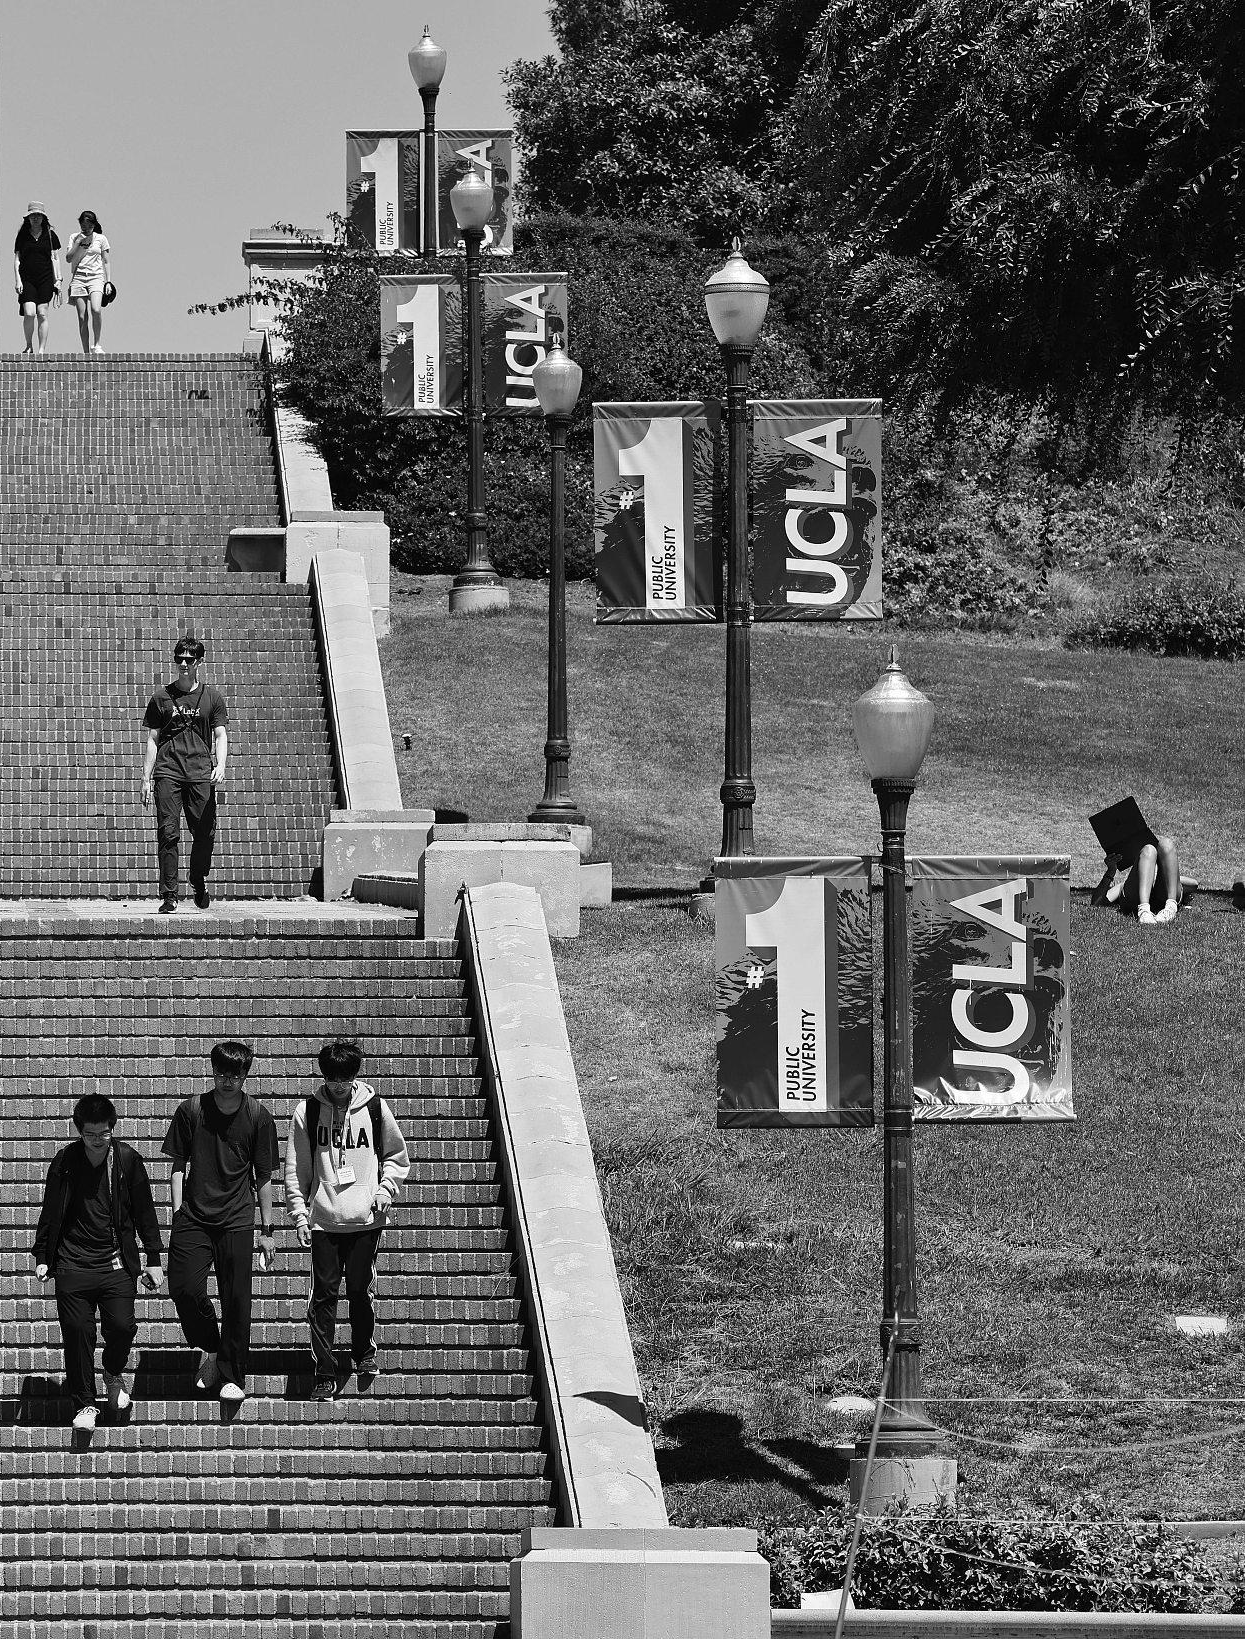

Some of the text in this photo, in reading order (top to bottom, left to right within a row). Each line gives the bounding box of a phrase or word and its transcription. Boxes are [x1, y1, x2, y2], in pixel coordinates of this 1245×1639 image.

[361, 138, 398, 250] #1
[379, 219, 387, 245] PUBLIC
[386, 201, 394, 246] UNIVERSITY
[397, 284, 439, 409] #1
[426, 354, 435, 404] UNIVERSITY
[418, 374, 426, 403] PUBLIC
[618, 417, 685, 609] #1
[783, 417, 848, 605] UCLA
[651, 555, 664, 600] PUBLIC
[664, 525, 677, 601] UNIVERSITY
[745, 876, 827, 1112] #1
[949, 878, 1030, 1105] UCLA
[786, 1046, 801, 1101] PUBLIC
[802, 1009, 817, 1102] UNIVERSITY
[318, 1125, 370, 1149] UCLA
